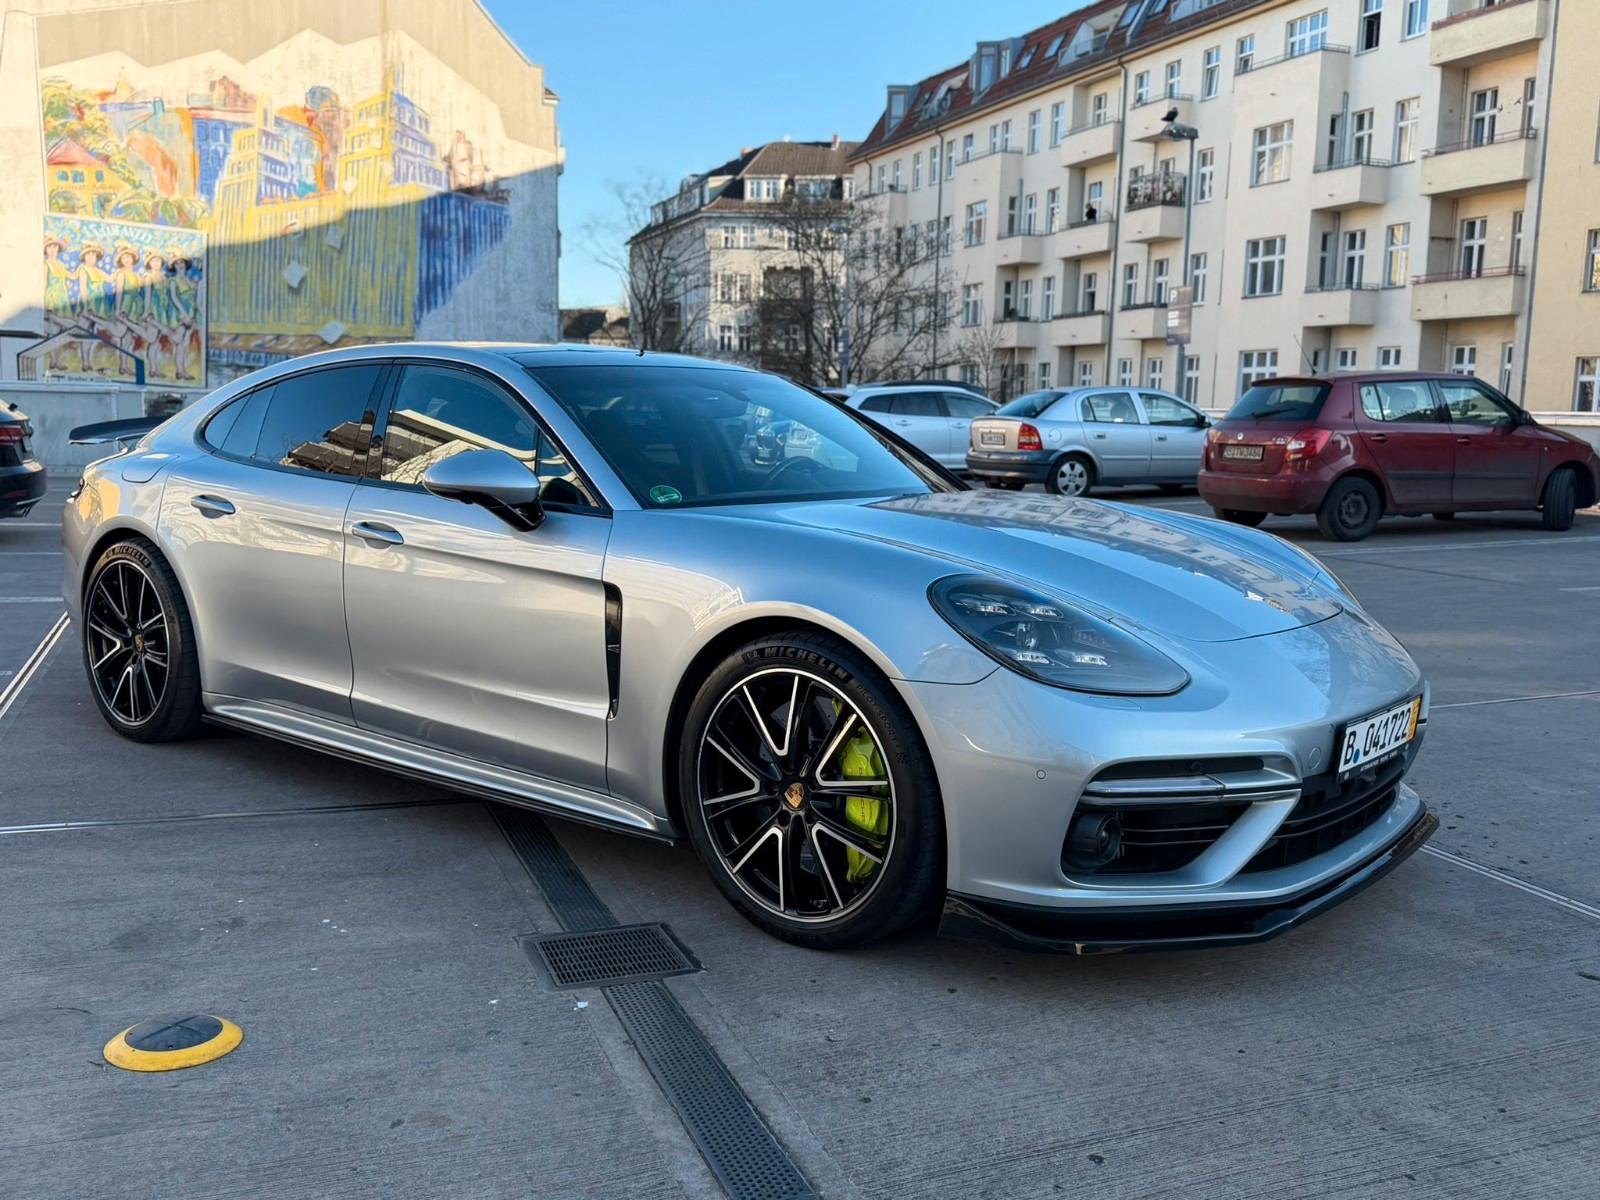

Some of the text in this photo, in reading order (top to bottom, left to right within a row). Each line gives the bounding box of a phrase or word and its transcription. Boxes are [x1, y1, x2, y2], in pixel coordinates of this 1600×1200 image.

[1170, 289, 1178, 303] P
[115, 546, 150, 566] MICHELIN
[764, 647, 849, 680] MICHELIN
[1343, 730, 1357, 766] B
[1363, 707, 1412, 757] 041722
